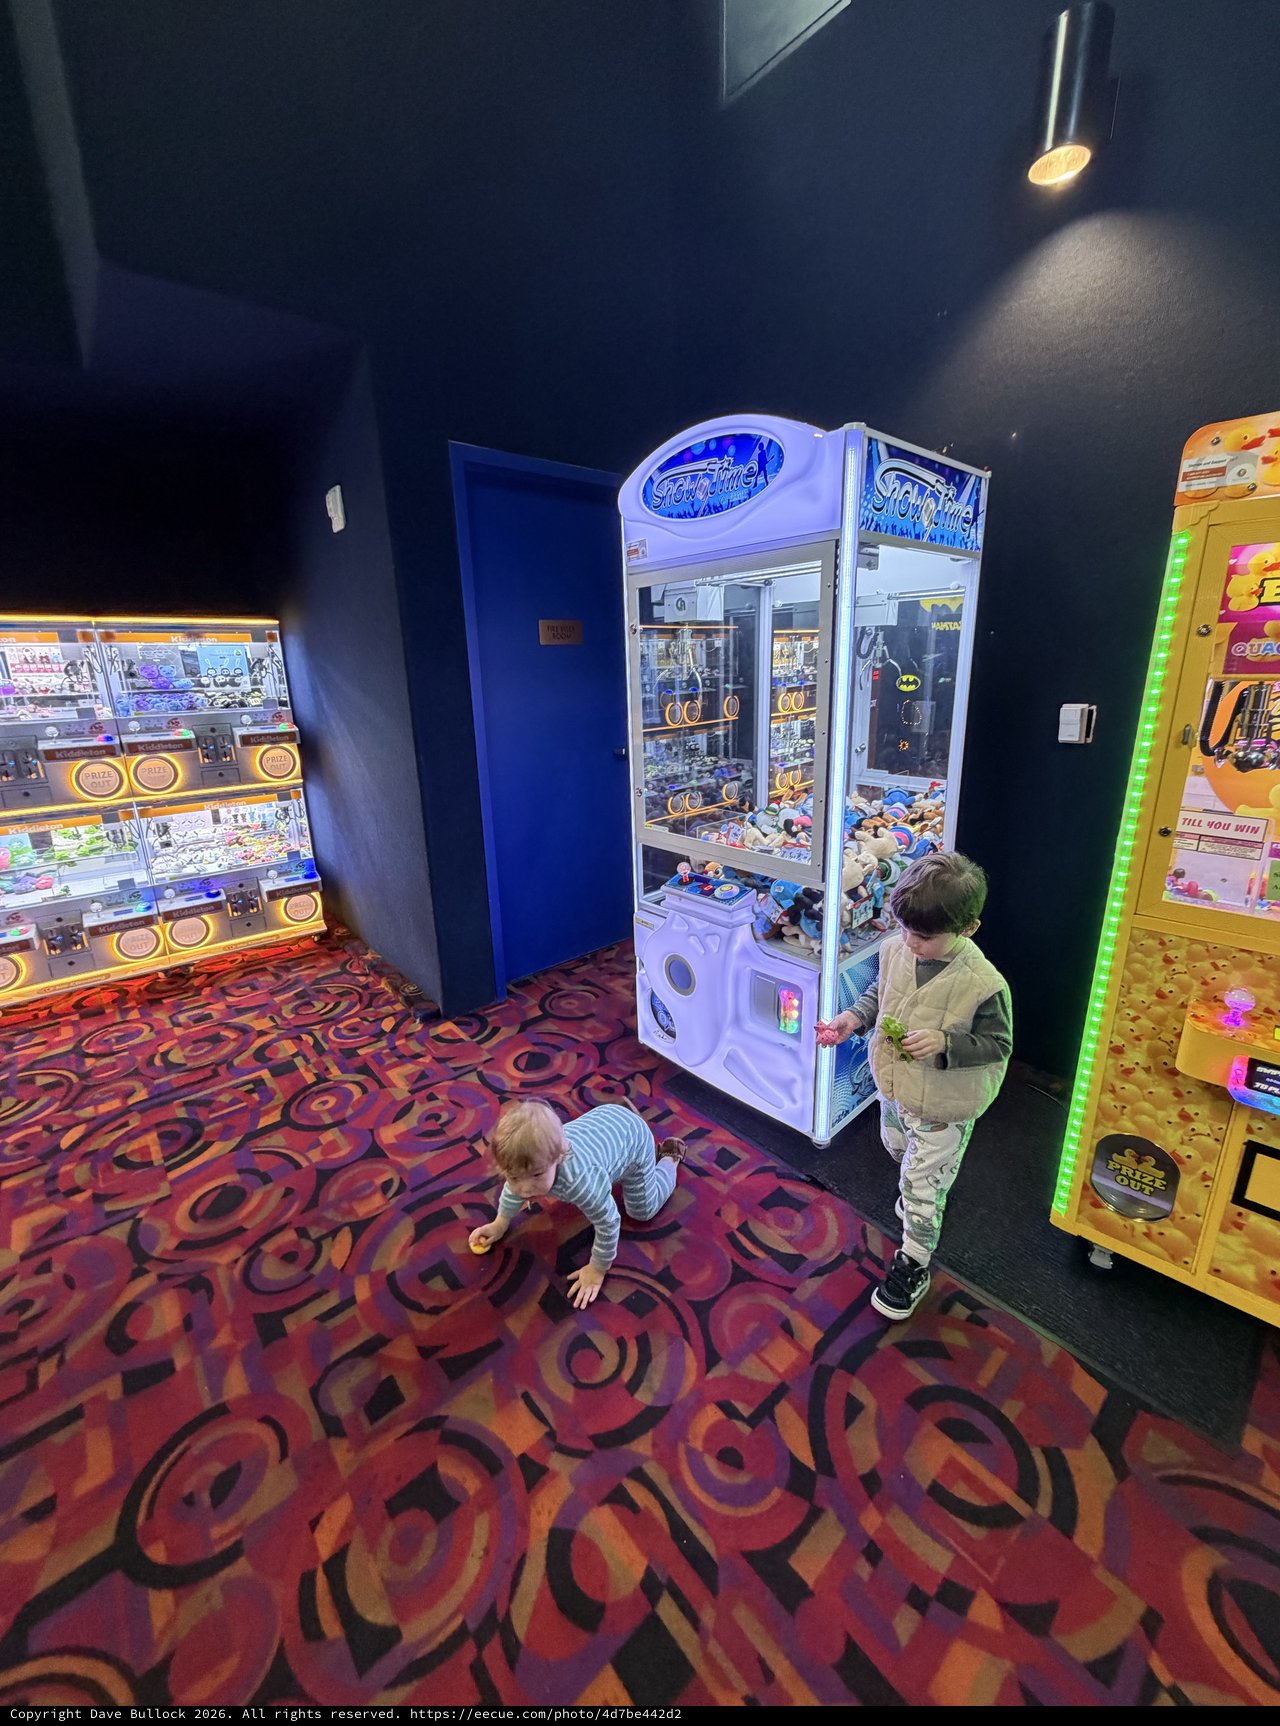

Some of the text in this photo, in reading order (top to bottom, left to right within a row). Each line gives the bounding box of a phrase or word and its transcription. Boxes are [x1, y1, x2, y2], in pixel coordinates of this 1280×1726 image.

[265, 755, 288, 764] PRIZE
[84, 771, 113, 780] PRIZE
[90, 780, 112, 789] OUT
[8, 823, 64, 835] Kiddleton
[1182, 817, 1260, 835] TILL YOU WIN
[1106, 1159, 1167, 1191] PRIZE
[1115, 1174, 1155, 1196] OUT
